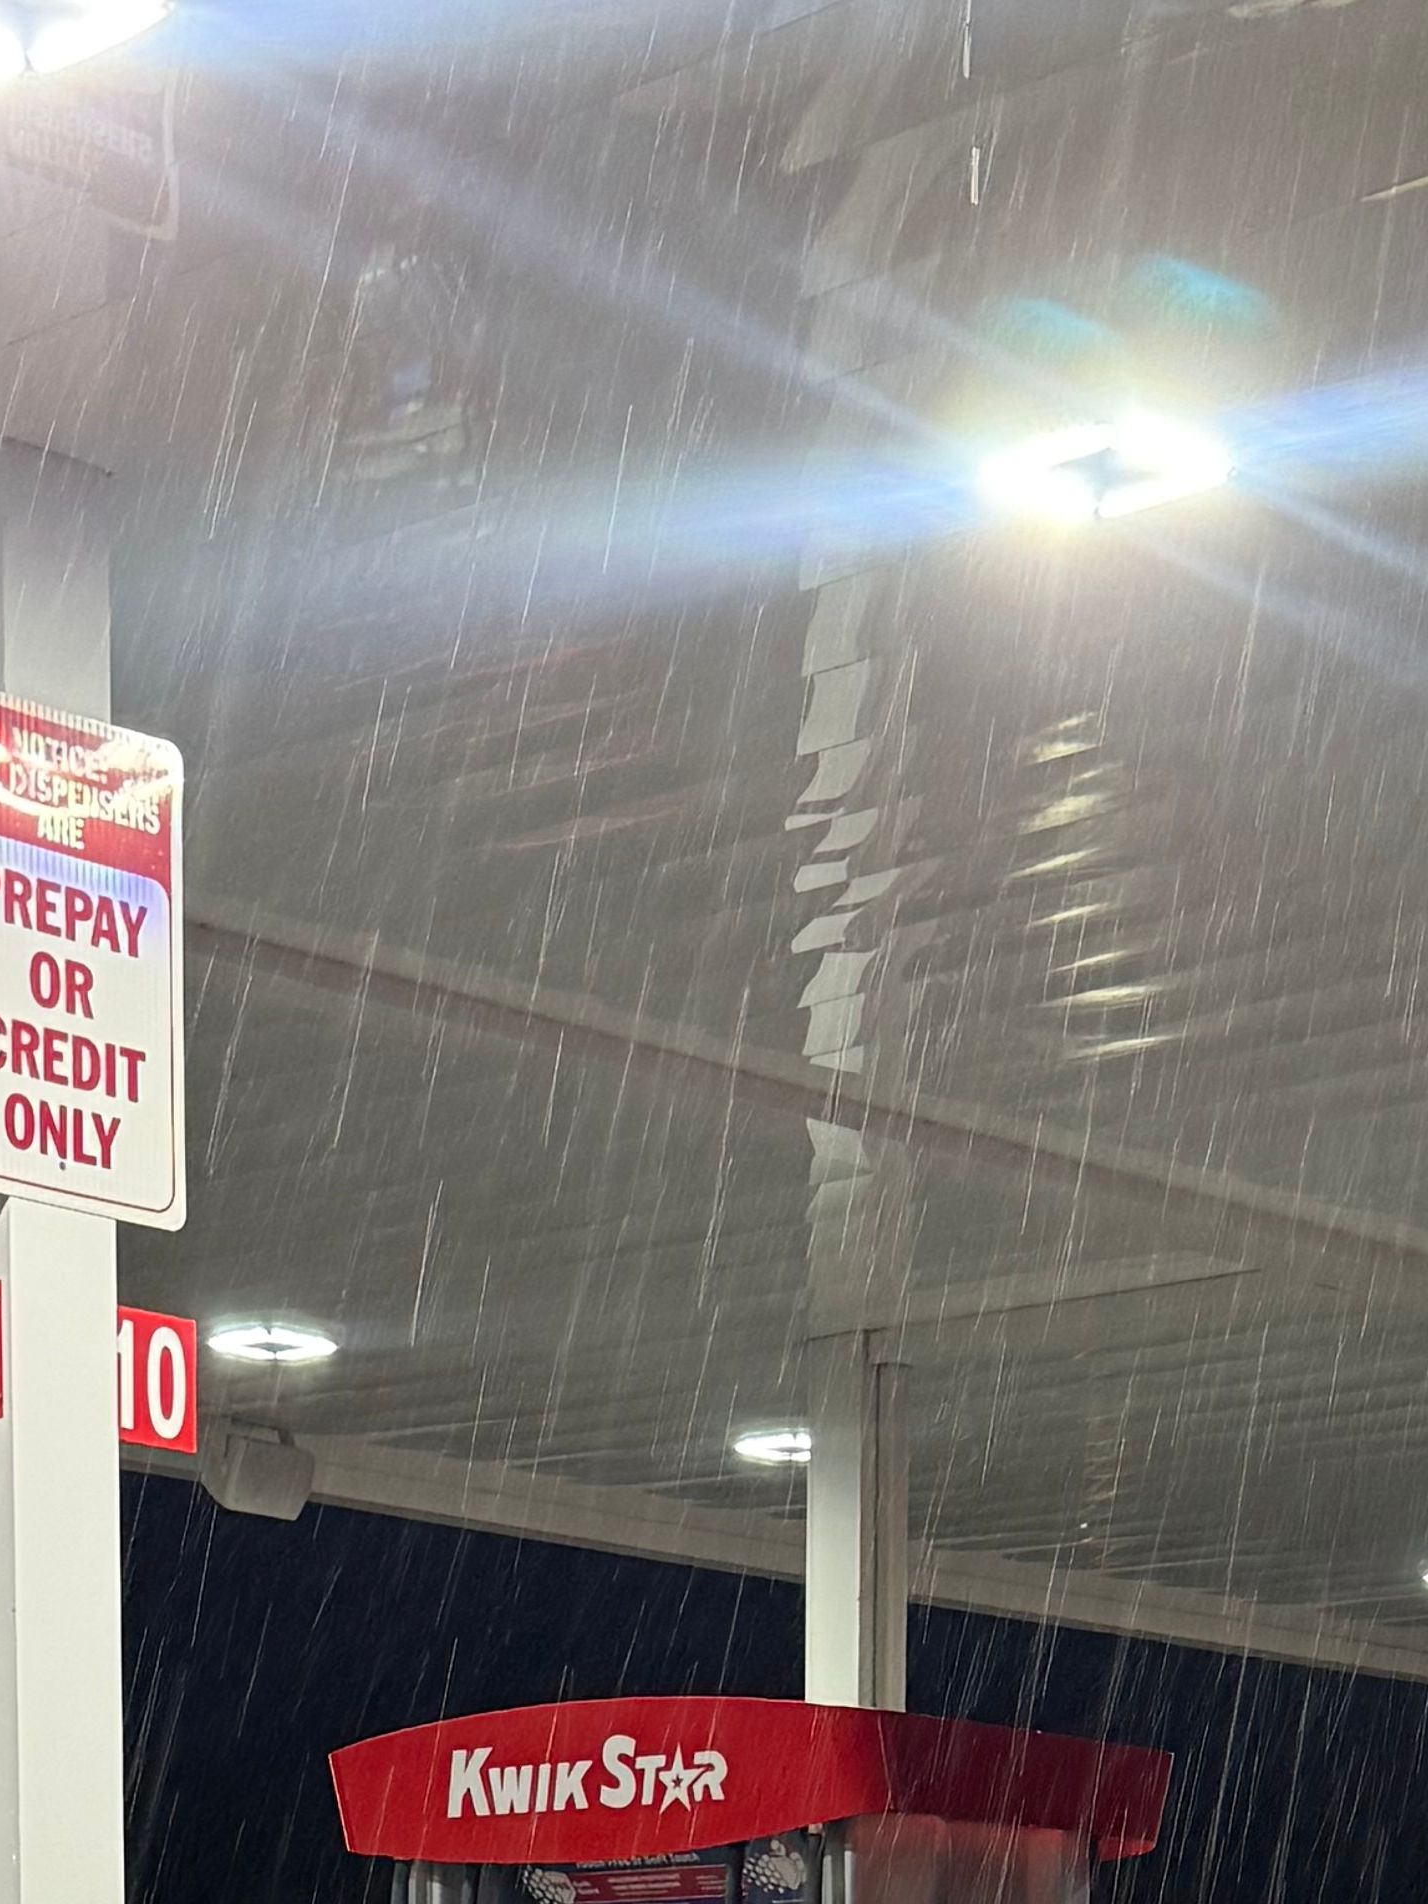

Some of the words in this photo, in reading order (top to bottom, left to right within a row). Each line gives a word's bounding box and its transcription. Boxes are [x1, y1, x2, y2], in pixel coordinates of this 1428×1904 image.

[13, 727, 108, 784] NOTICE:
[9, 763, 161, 835] DISPENSERS
[37, 814, 85, 849] ARE
[30, 951, 94, 1019] OR
[4, 1093, 121, 1169] ONLY
[117, 1319, 186, 1440] 10
